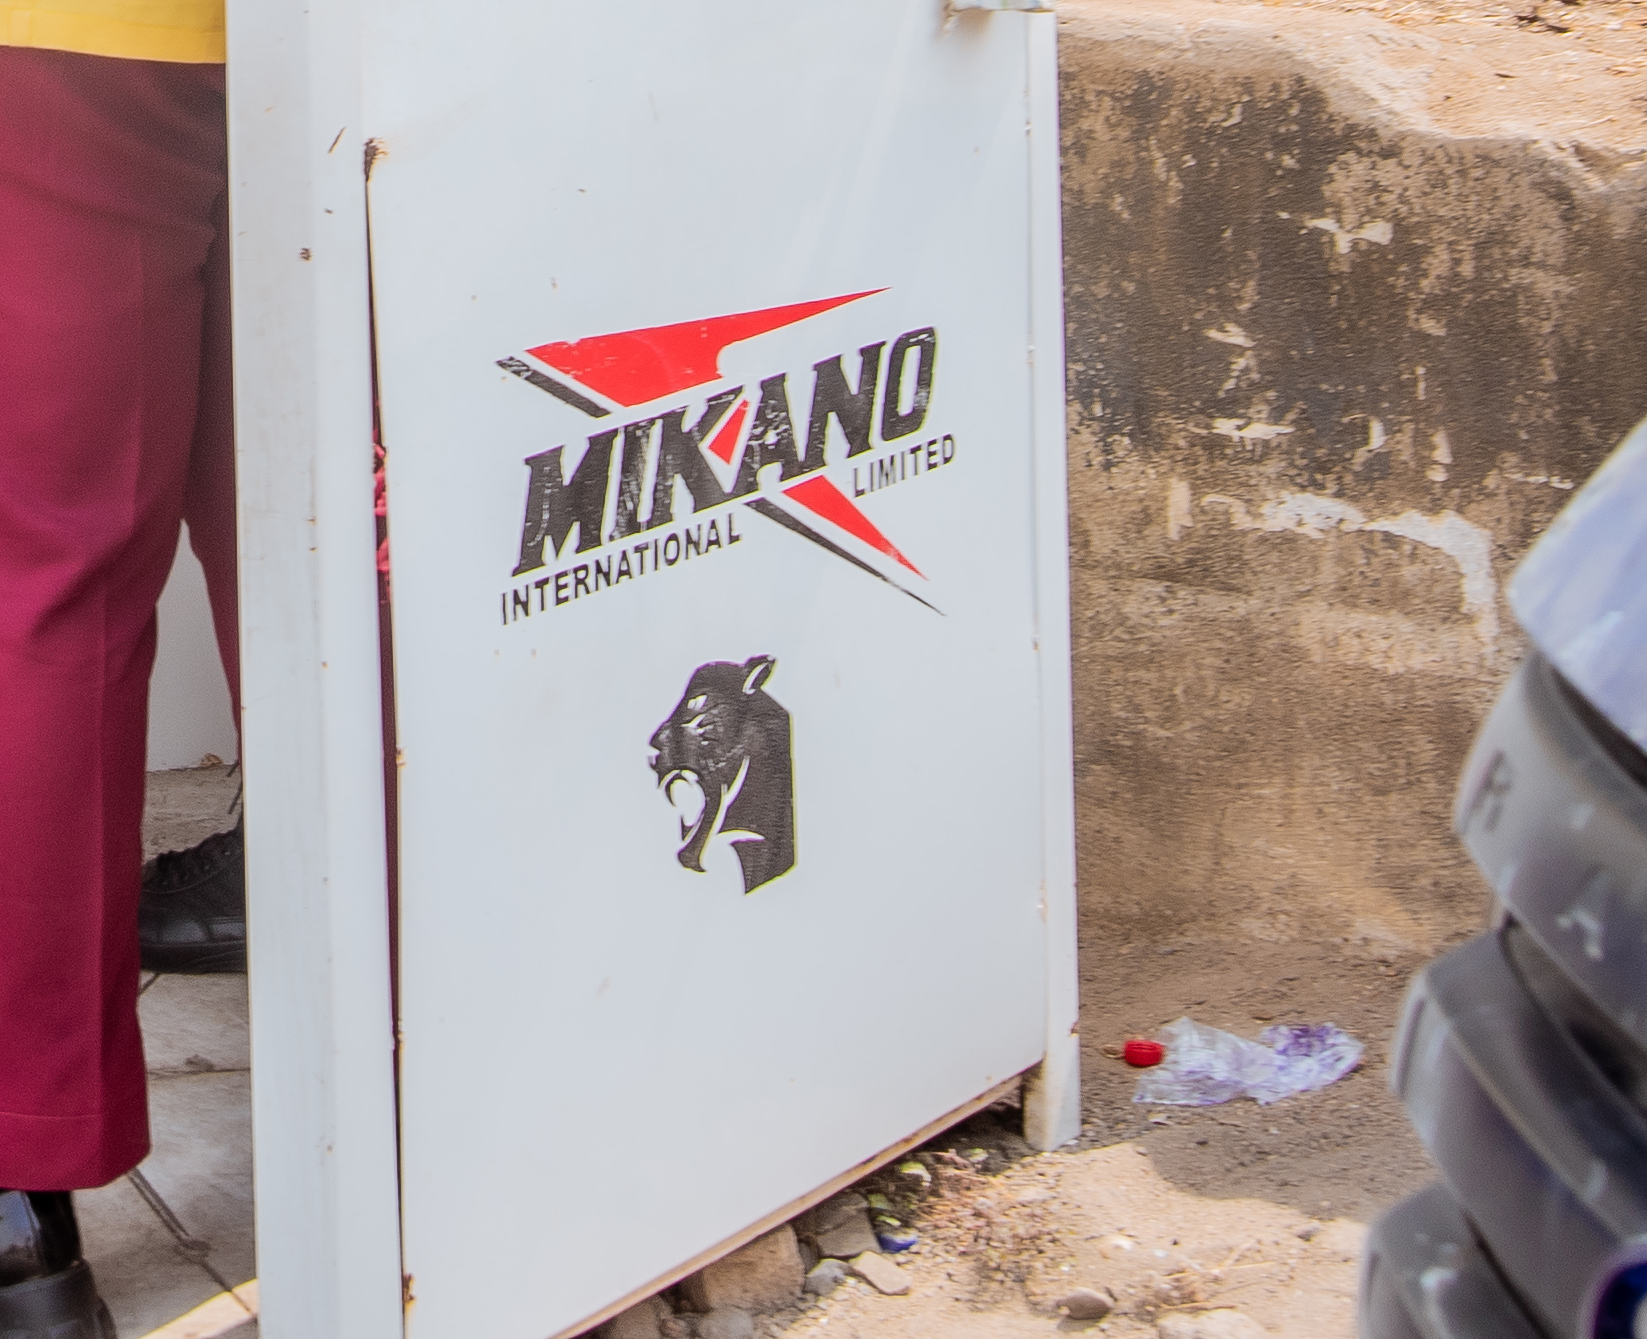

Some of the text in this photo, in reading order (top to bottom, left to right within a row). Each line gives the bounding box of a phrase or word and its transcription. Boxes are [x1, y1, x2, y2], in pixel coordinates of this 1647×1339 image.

[500, 433, 956, 626] INTERNATIONAL LIMITED
[511, 326, 937, 578] MIKANO
